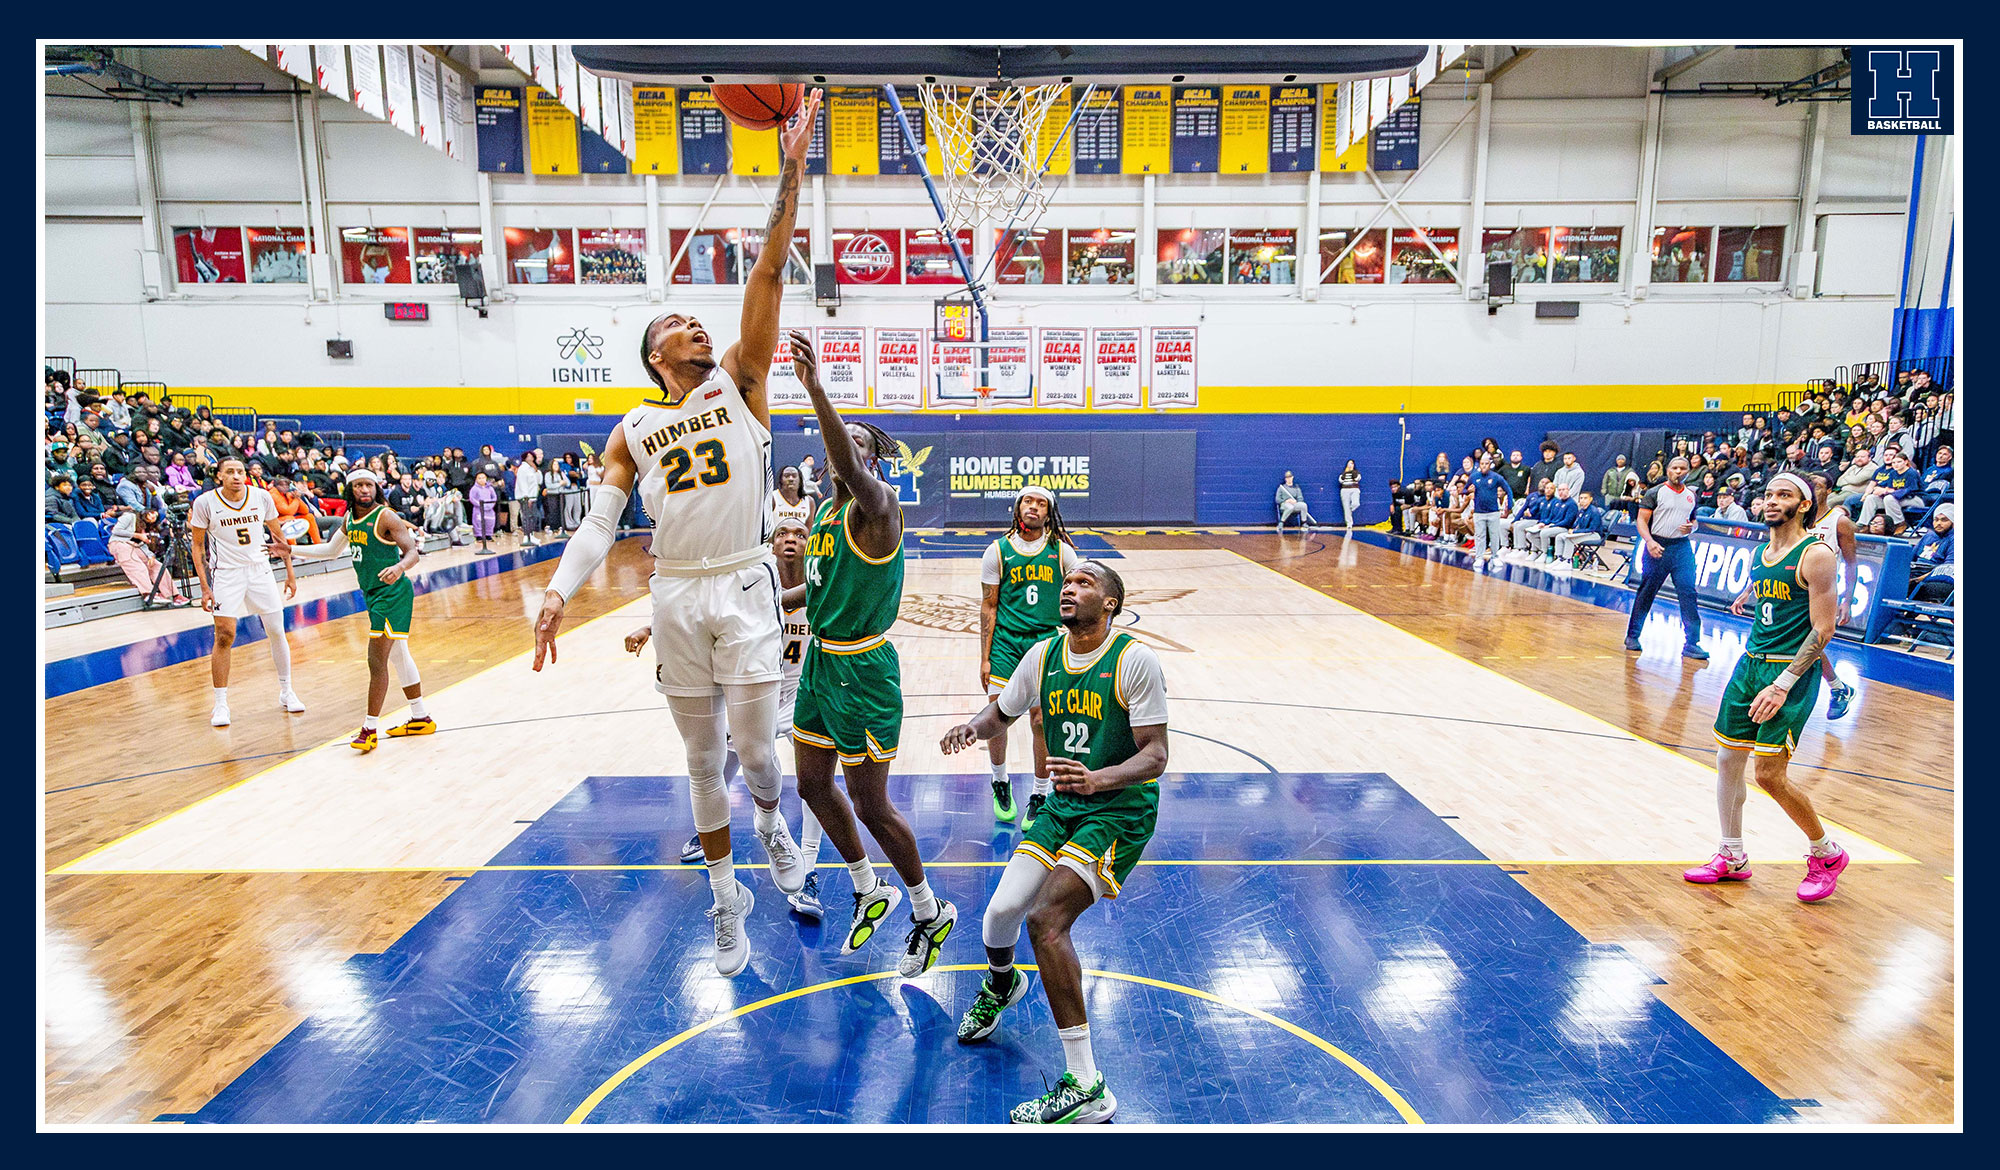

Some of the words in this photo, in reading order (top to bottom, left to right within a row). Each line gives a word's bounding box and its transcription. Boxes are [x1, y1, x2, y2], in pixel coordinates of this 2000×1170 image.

[823, 342, 860, 353] OCAA
[880, 344, 917, 354] OCAA
[1045, 343, 1080, 353] OCAA
[1099, 343, 1135, 354] OCAA
[1156, 342, 1191, 353] OCAA
[821, 355, 861, 363] CHAMPIONS
[879, 356, 918, 364] CHAMPIONS
[1043, 355, 1081, 364] CHAMPIONS
[1097, 355, 1137, 364] CHAMPIONS
[1154, 354, 1192, 363] CHAMPIONS
[553, 368, 612, 382] IGNITE
[641, 406, 732, 457] HUMBER
[659, 437, 732, 495] 23
[951, 456, 1012, 475] HOME
[1017, 456, 1047, 475] OF
[1050, 456, 1090, 474] THE
[951, 475, 1023, 490] HUMBER
[1028, 475, 1090, 489] HAWKS
[220, 514, 260, 528] HUMBER
[236, 528, 252, 546] 5
[352, 545, 363, 562] 23
[806, 557, 822, 586] 14
[1010, 566, 1024, 584] ST.
[1026, 564, 1053, 584] CLAIR
[1026, 584, 1038, 605] 6
[1763, 578, 1792, 600] CLAIR
[1761, 602, 1773, 625] 9
[784, 640, 802, 664] 4
[1048, 690, 1063, 716] ST.
[1066, 688, 1103, 721] CLAIR
[1061, 721, 1090, 754] 22
